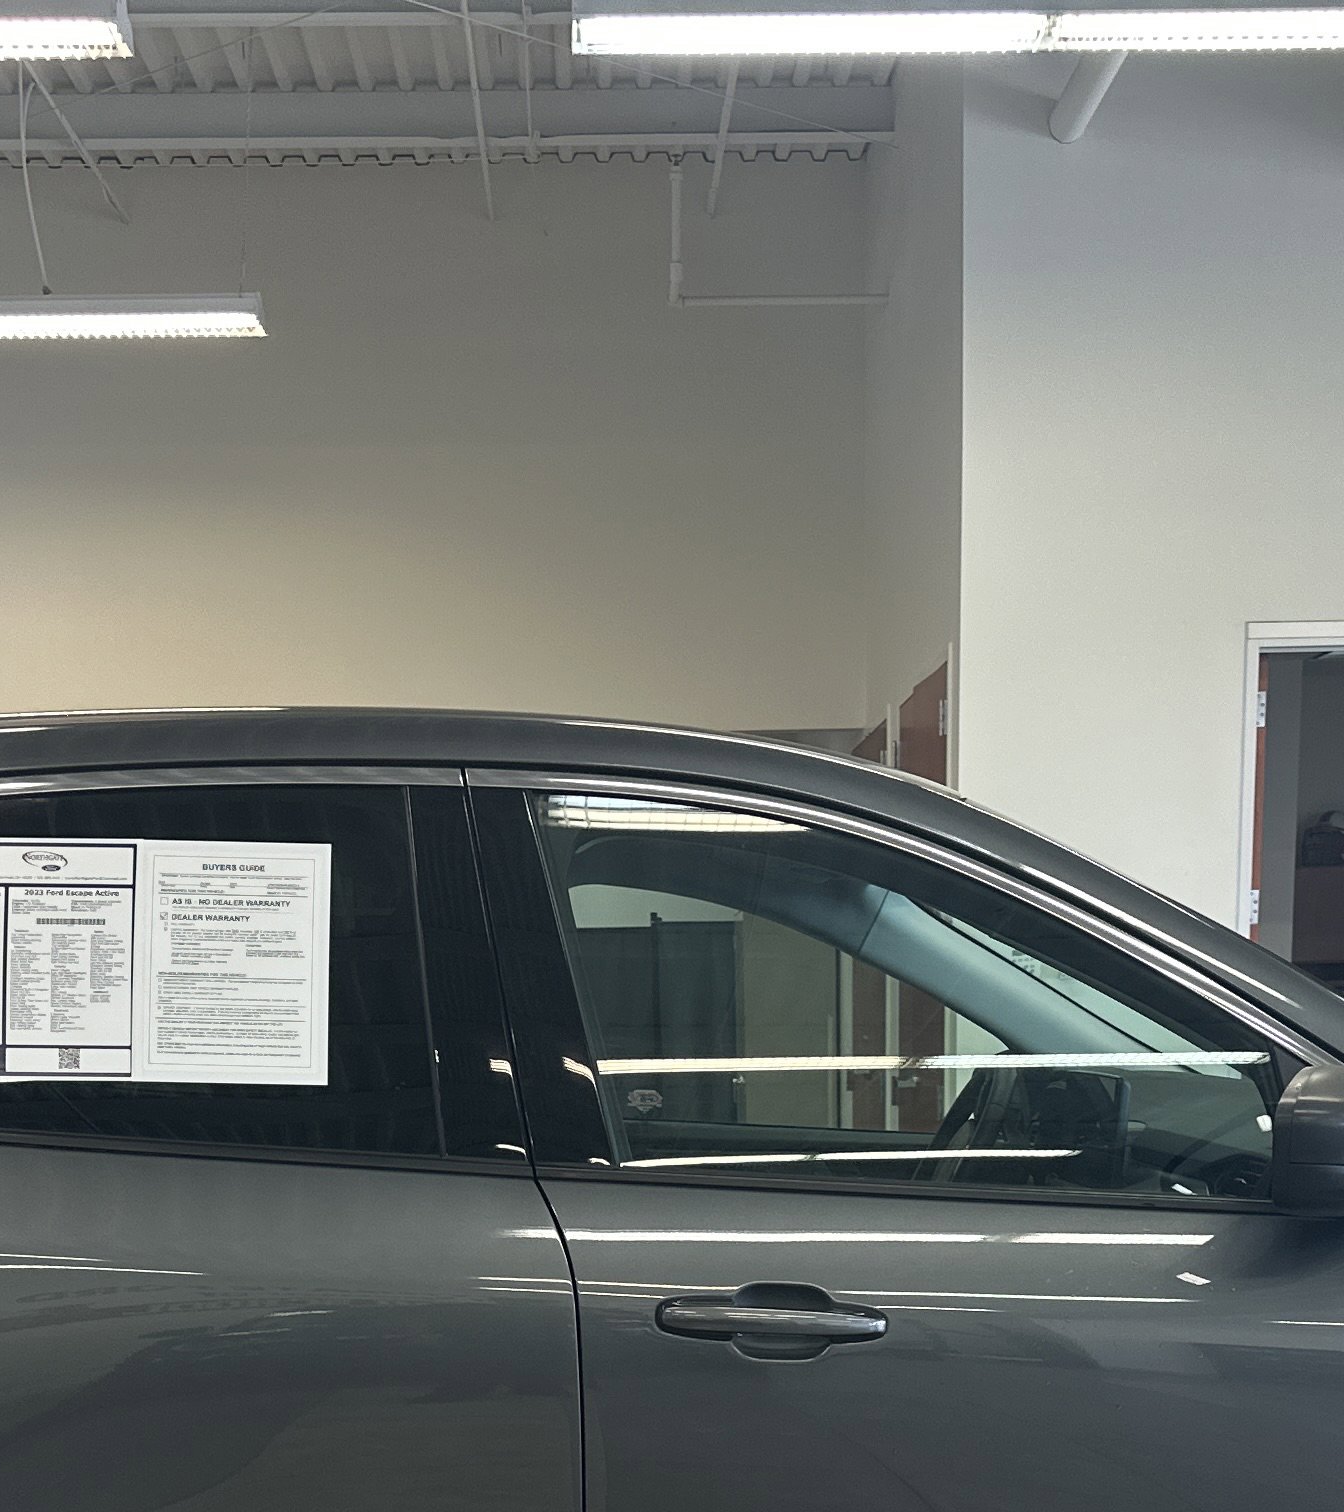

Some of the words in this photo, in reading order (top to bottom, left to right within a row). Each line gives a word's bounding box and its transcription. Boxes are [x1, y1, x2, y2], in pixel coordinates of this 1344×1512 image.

[202, 863, 237, 872] BUYERS
[239, 864, 266, 873] GUIDE
[65, 889, 93, 897] Escape
[212, 899, 244, 907] DEALER
[246, 900, 291, 908] WARRANTY
[205, 914, 251, 922] WARRANTY
